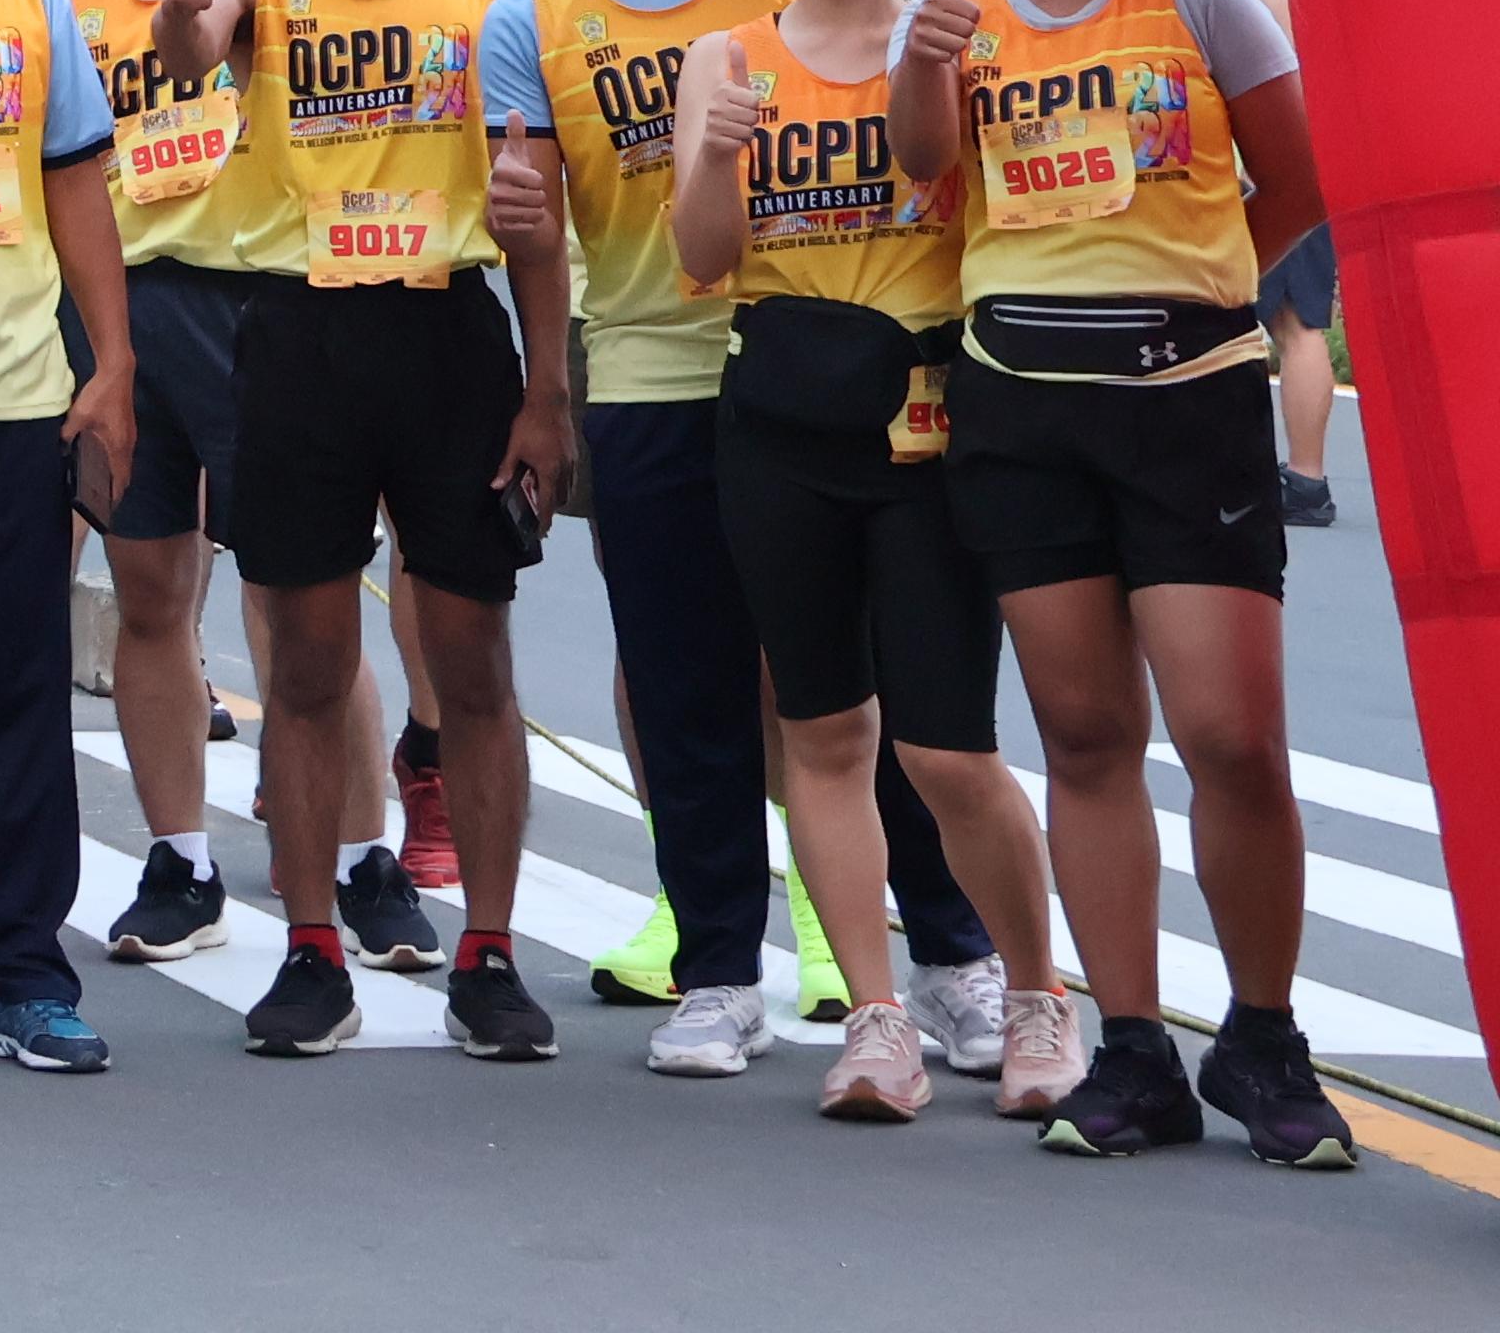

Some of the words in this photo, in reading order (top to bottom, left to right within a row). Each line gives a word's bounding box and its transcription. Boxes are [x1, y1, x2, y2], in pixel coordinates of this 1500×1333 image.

[286, 18, 318, 36] 85TH
[288, 25, 412, 98] QCPD
[587, 43, 621, 69] 85TH
[593, 42, 694, 128] QCP
[295, 87, 407, 117] ANNIVERSARY
[131, 128, 227, 176] 9098
[748, 115, 892, 195] QCPD
[1003, 146, 1116, 195] 9026
[341, 191, 375, 207] QCPD
[753, 185, 884, 216] ANNIVERSARY
[329, 225, 428, 257] 9017
